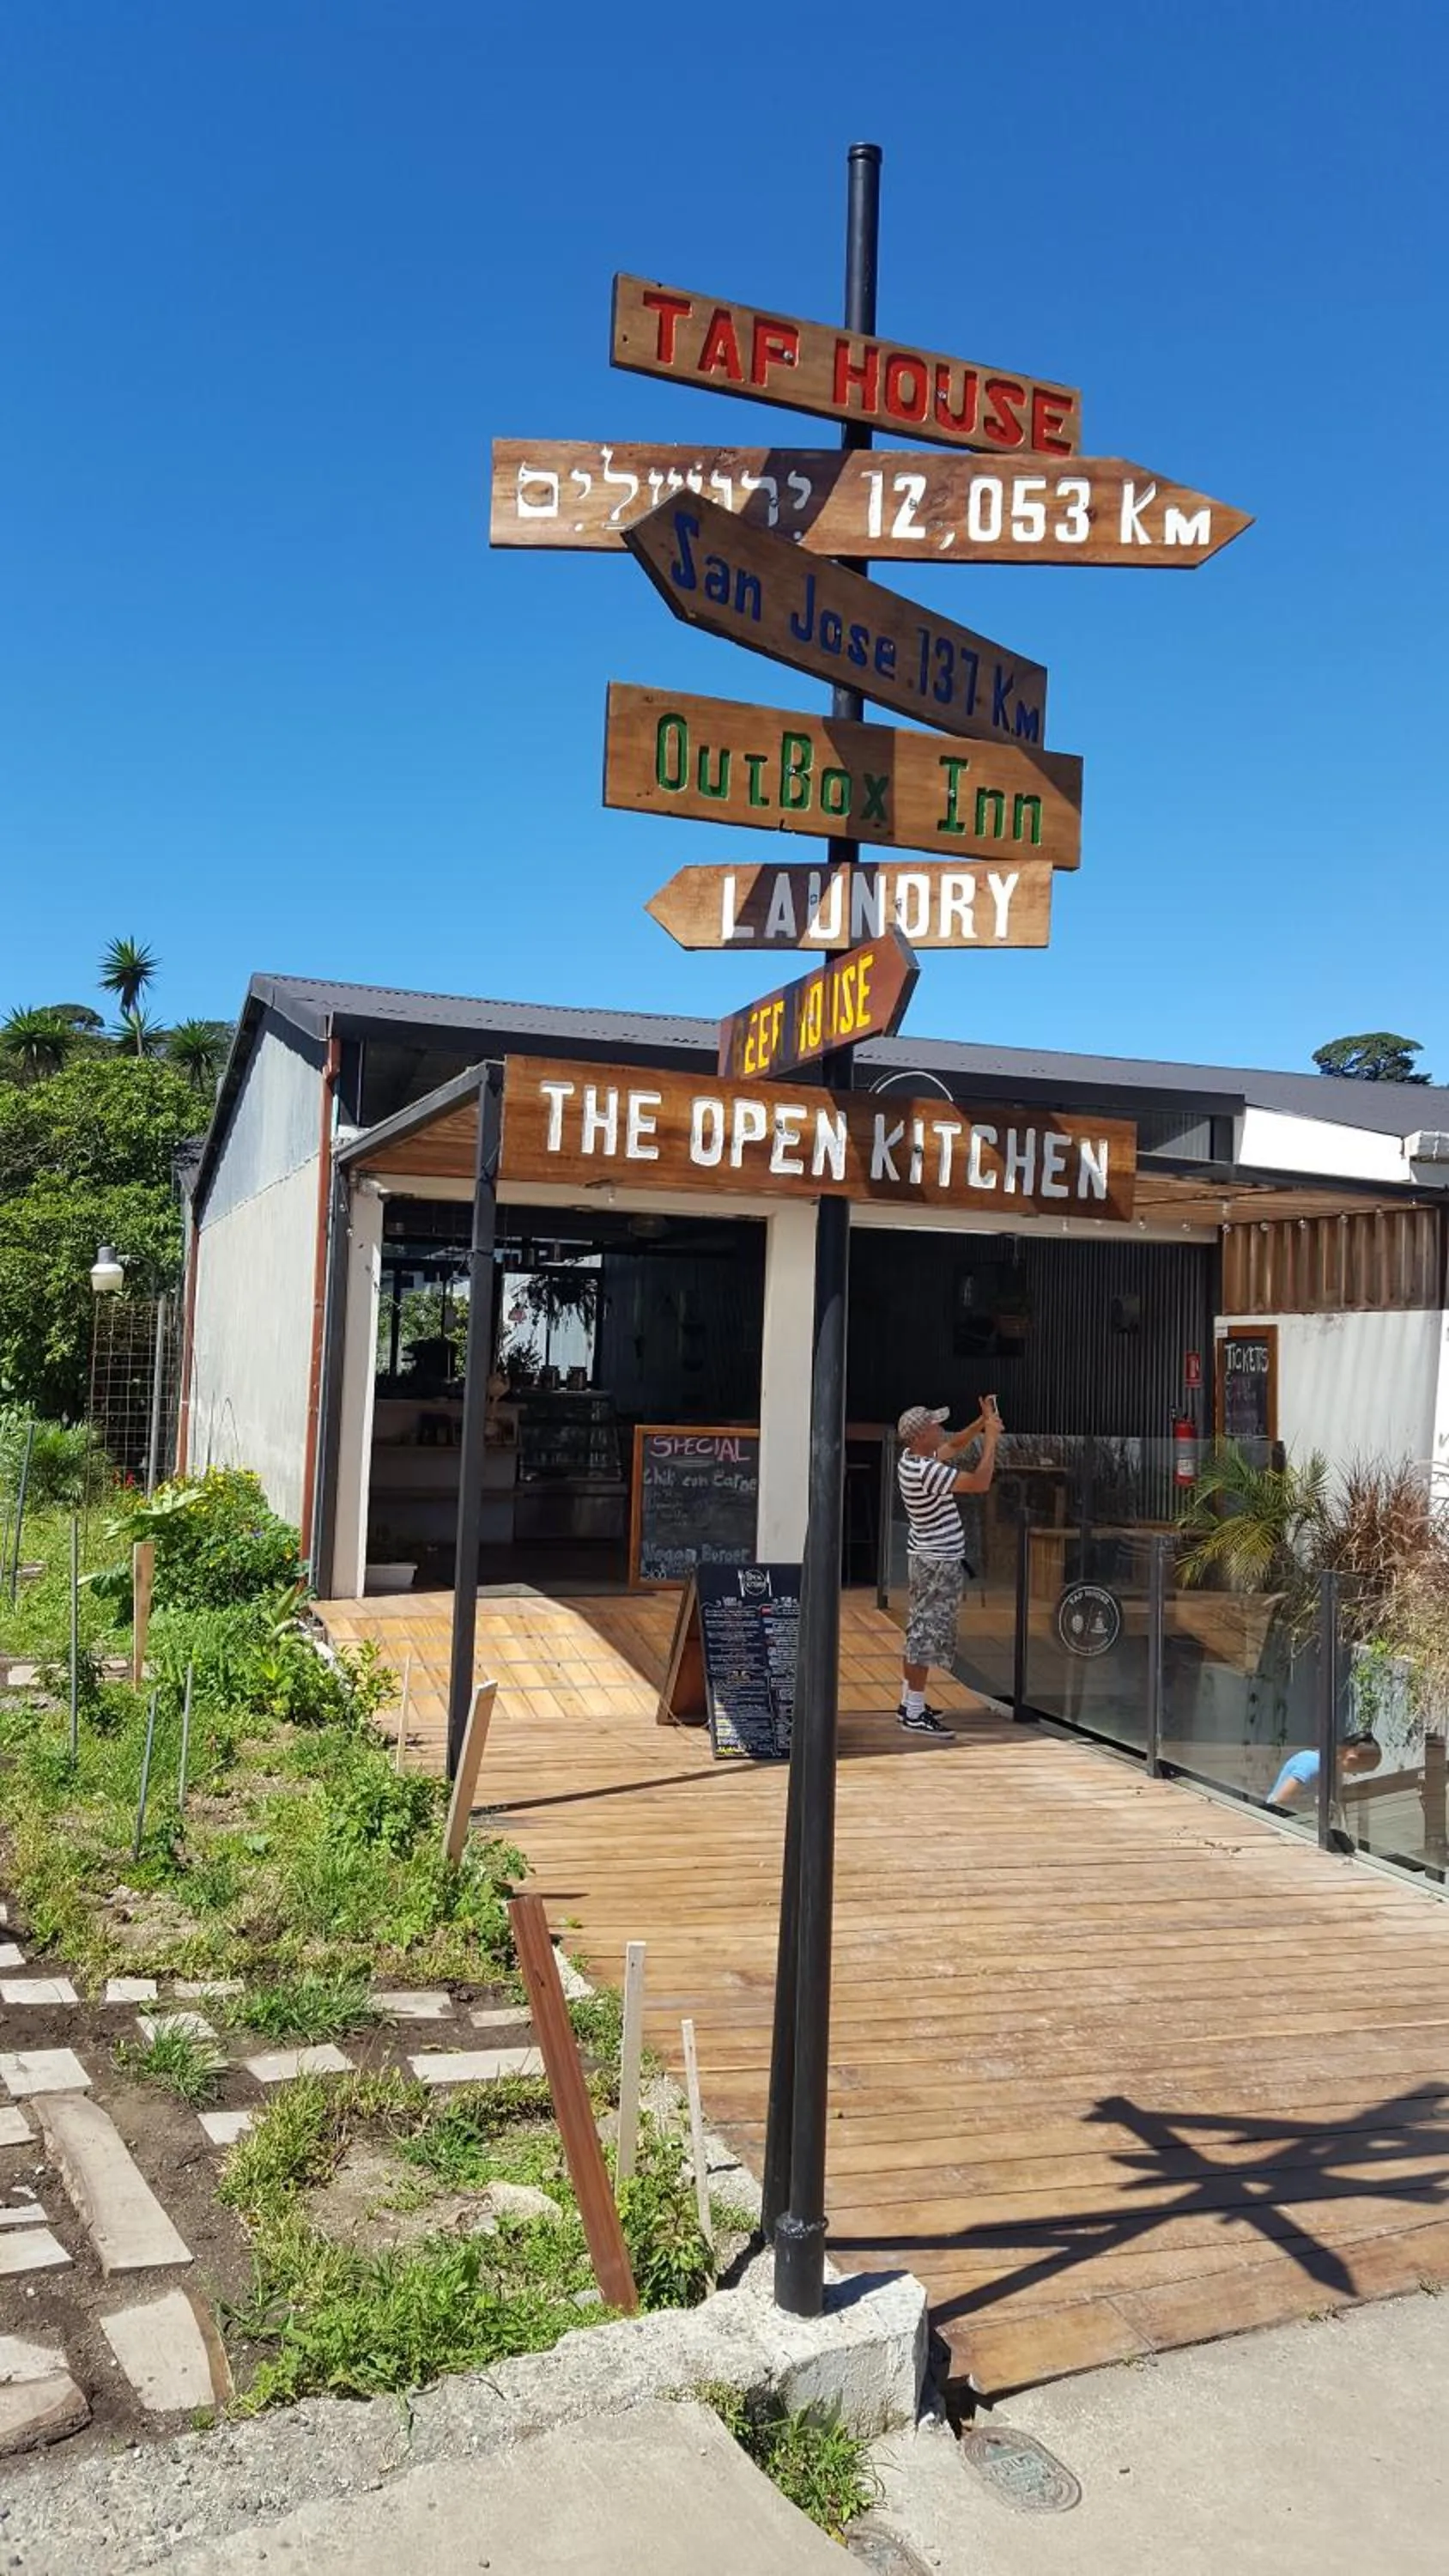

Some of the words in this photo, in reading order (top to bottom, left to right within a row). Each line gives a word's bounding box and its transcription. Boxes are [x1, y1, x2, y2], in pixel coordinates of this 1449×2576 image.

[643, 290, 799, 387] TAP
[832, 337, 1074, 460] HOUSE
[860, 470, 1092, 550] 12,053
[670, 510, 761, 623] San
[790, 573, 897, 681] Jose
[937, 754, 1043, 846] Inn
[721, 871, 1021, 940] LAUNDRY
[540, 1079, 663, 1160] THE
[689, 1095, 848, 1181] OPEN
[870, 1113, 1108, 1200] KITCHEN
[650, 1436, 752, 1462] SPECIAL
